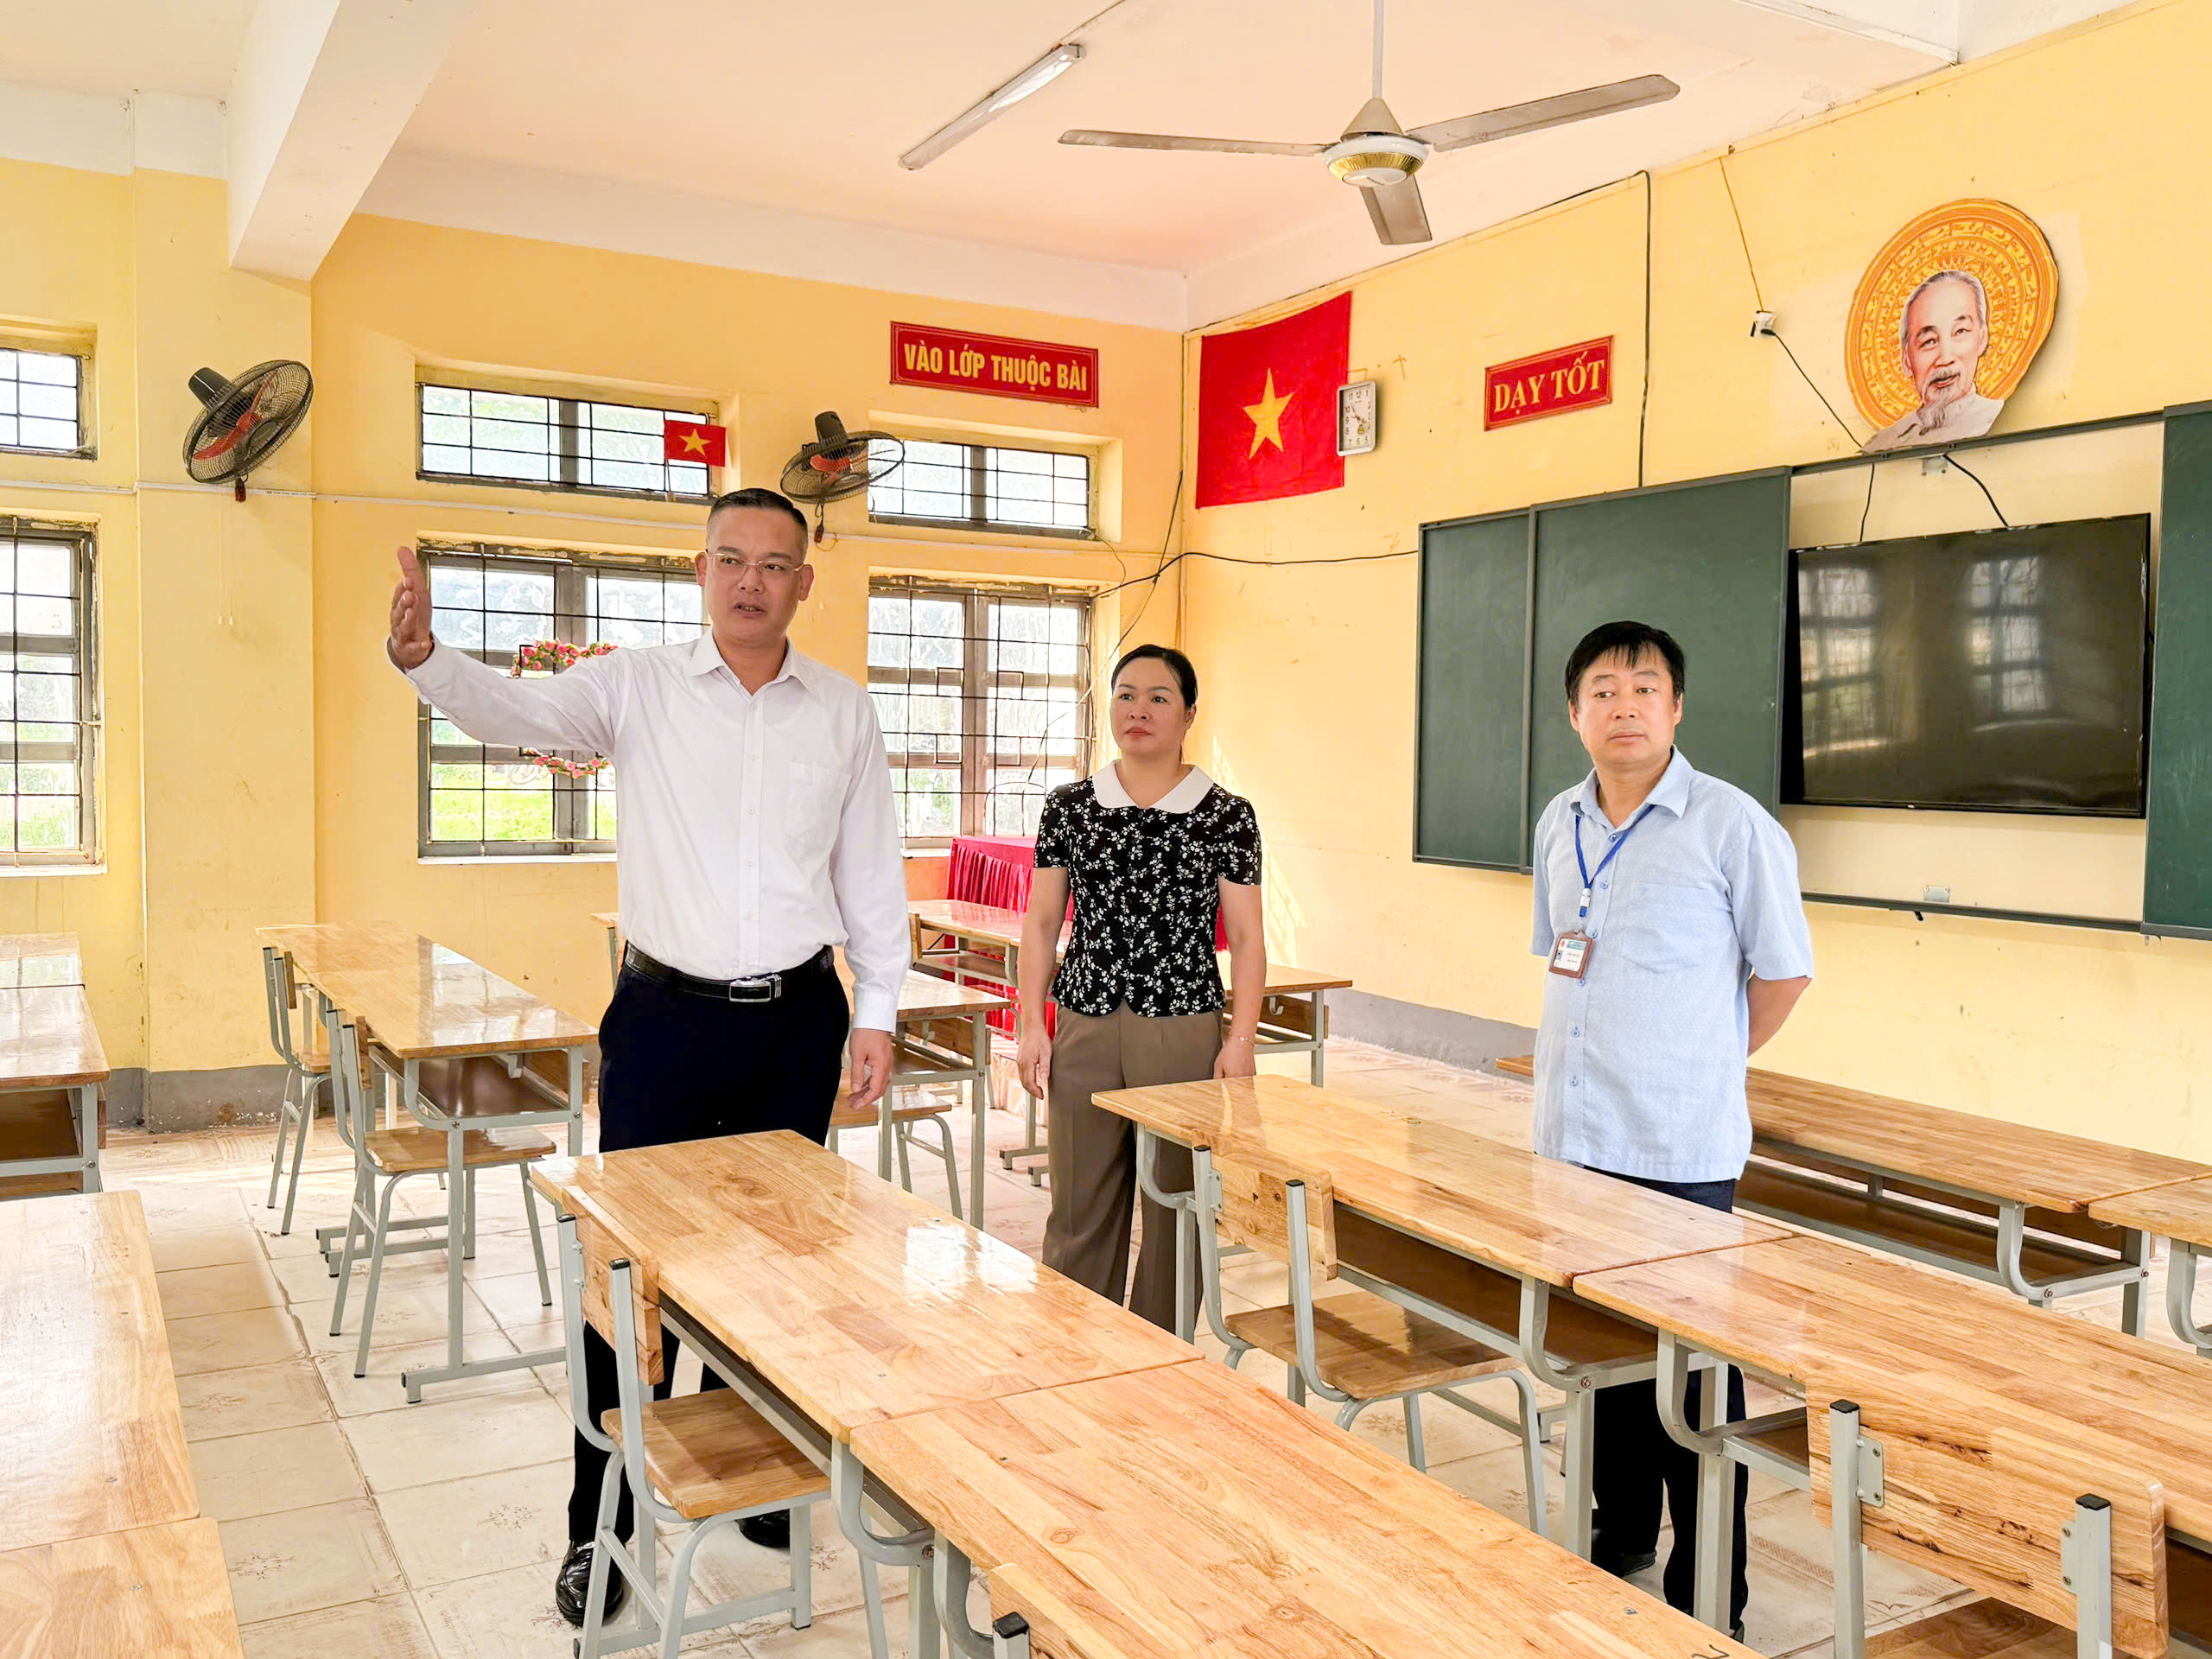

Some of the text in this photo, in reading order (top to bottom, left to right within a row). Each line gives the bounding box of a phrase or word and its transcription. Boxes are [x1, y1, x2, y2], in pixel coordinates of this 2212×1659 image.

[904, 340, 1087, 391] VÀO LỚP THUỘC BÀI
[1494, 350, 1605, 416] DẠY TỐT
